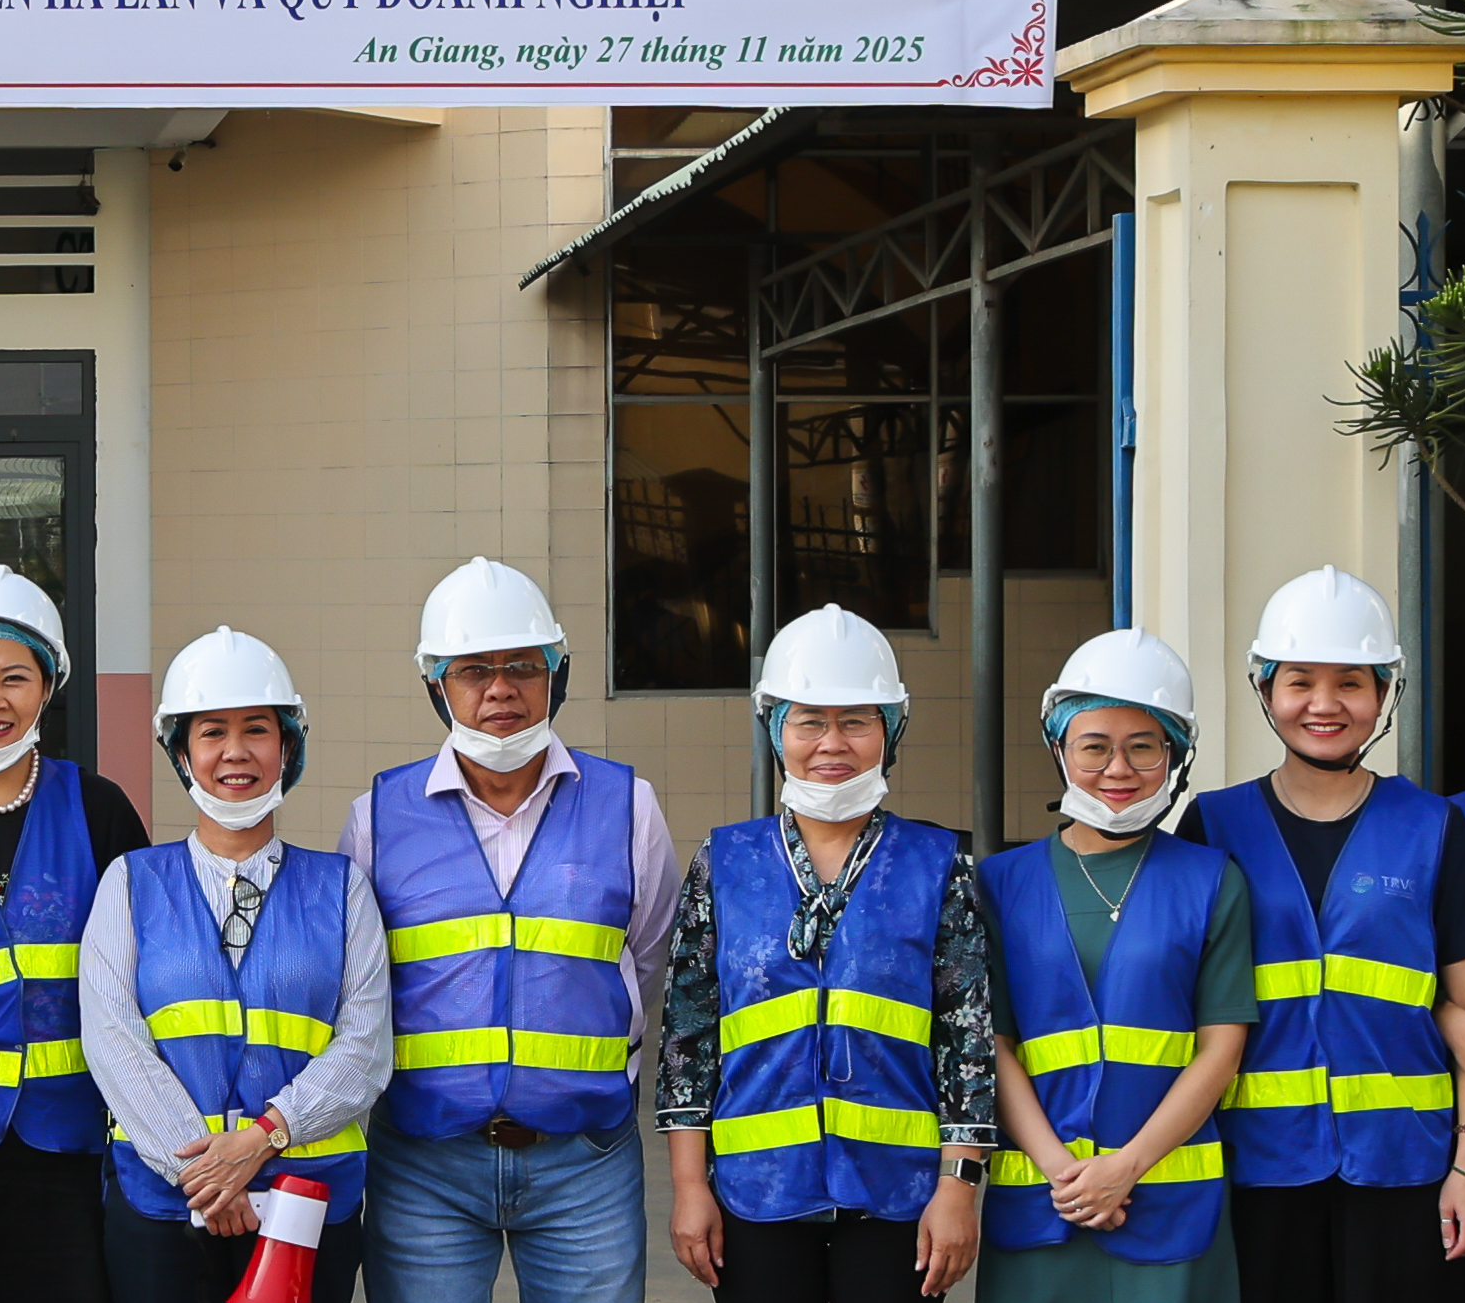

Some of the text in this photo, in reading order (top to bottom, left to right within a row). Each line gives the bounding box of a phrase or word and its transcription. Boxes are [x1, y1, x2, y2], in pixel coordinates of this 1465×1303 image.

[353, 35, 925, 72] An Giang, ngày 27 tháng 11 năm 2025
